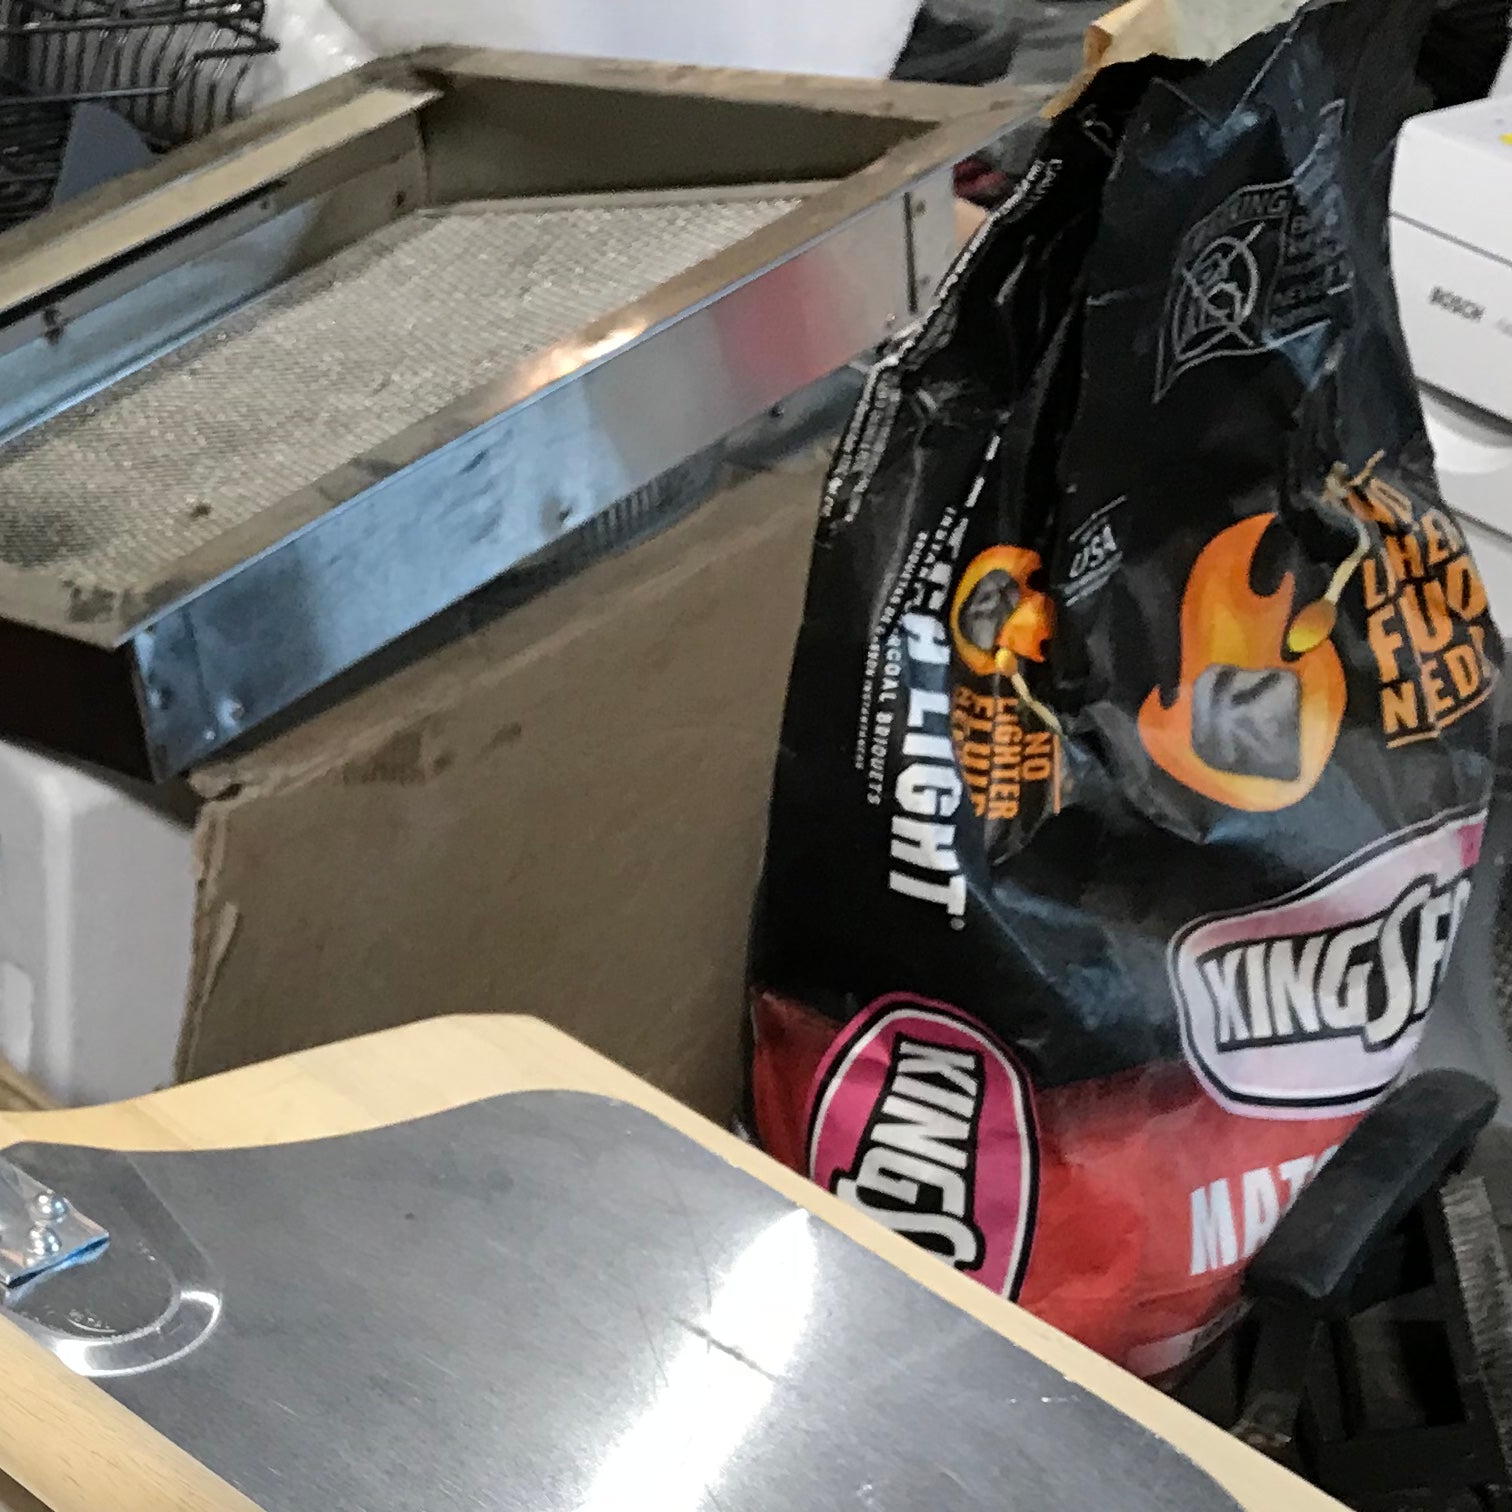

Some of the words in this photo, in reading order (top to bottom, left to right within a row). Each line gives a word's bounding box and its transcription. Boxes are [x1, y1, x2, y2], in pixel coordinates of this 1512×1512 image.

[1429, 286, 1485, 321] BOSCH
[1069, 525, 1117, 578] USA
[986, 696, 1024, 820] LIGHTER
[1023, 731, 1052, 781] NO
